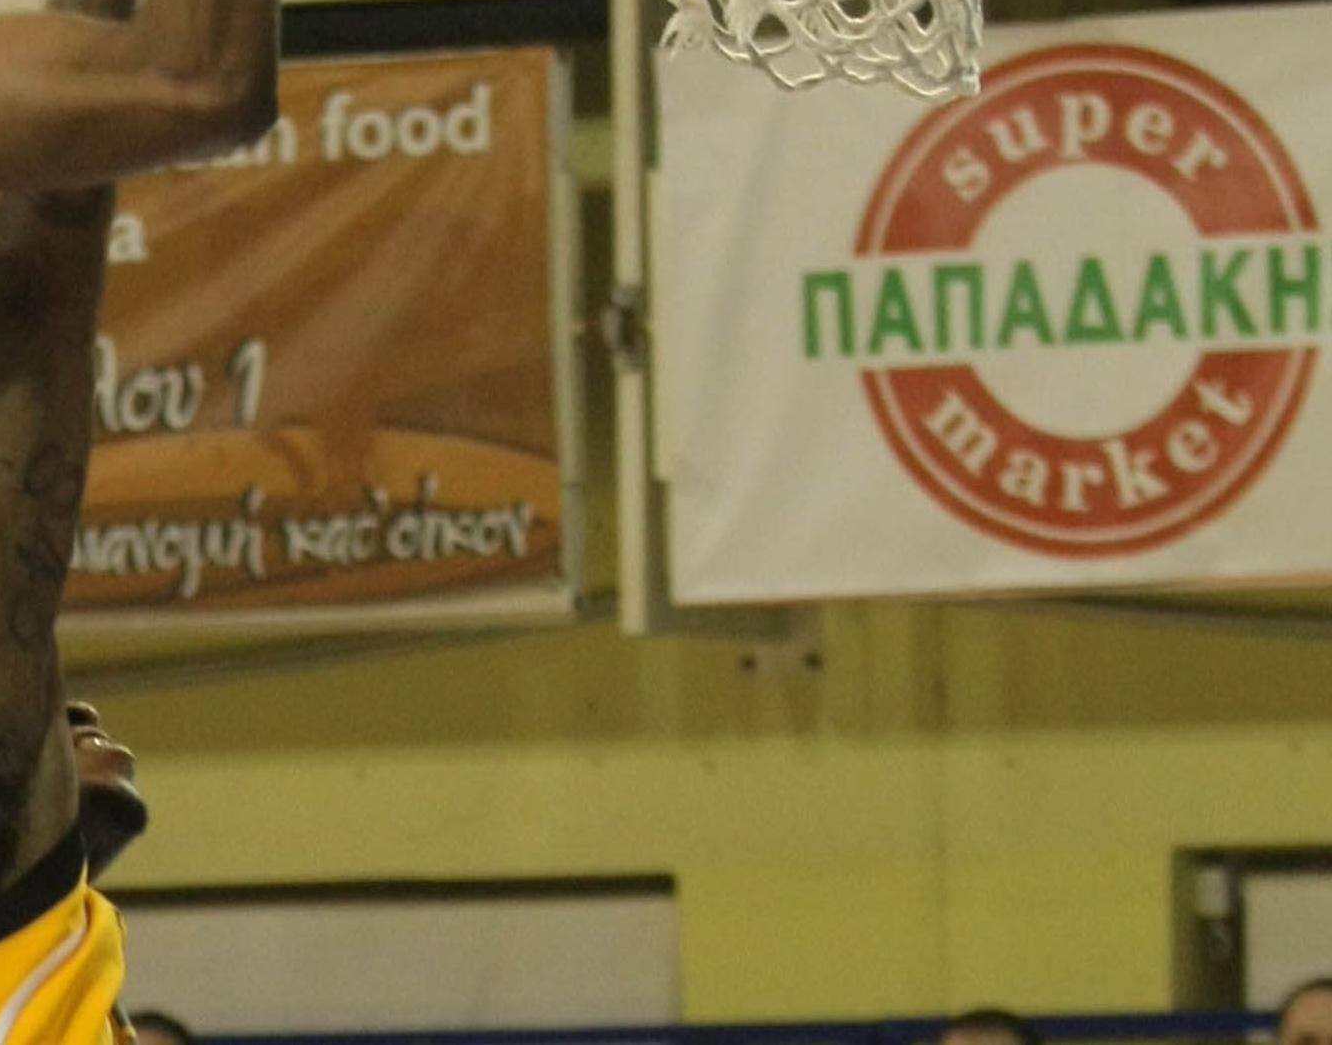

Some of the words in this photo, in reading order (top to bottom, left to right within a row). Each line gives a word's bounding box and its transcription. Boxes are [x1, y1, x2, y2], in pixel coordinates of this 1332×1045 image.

[320, 84, 491, 163] food
[941, 91, 1228, 203] super
[802, 244, 1332, 359] ΠΑΠΑΔΑΚΗ
[922, 376, 1255, 512] market
